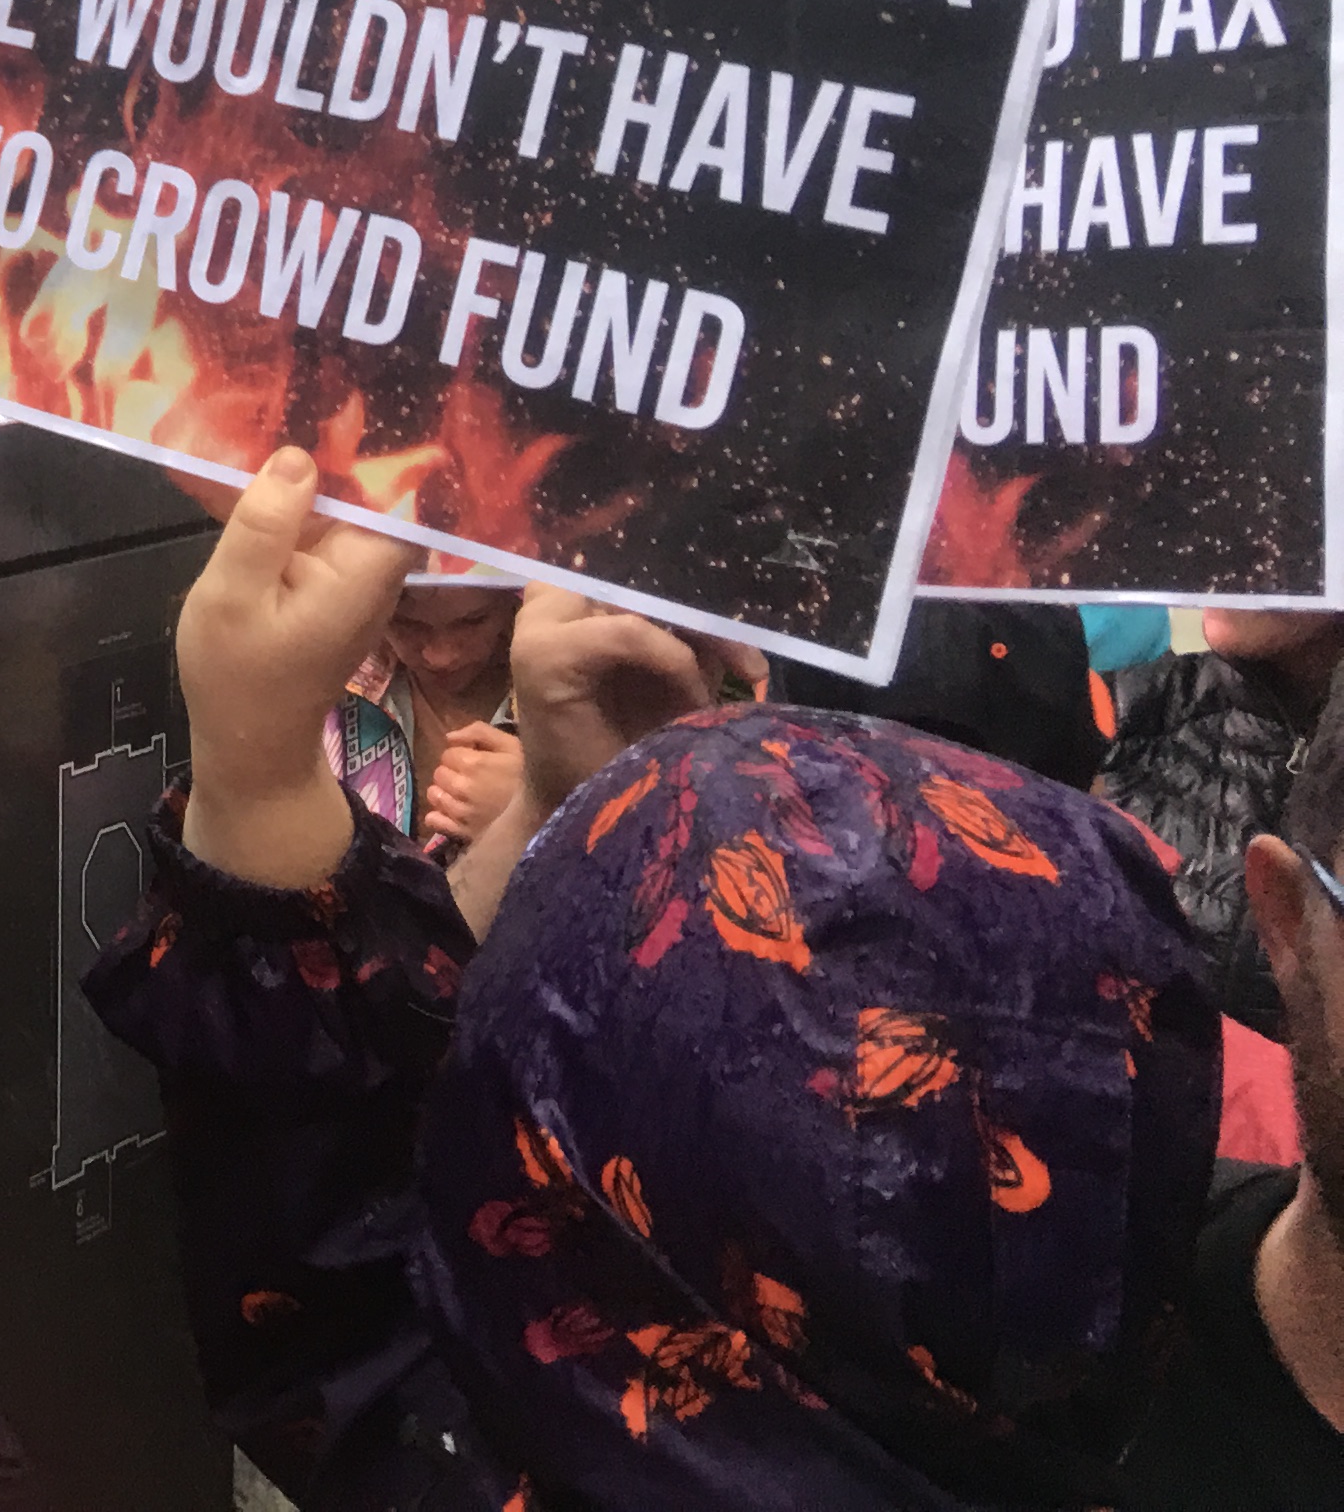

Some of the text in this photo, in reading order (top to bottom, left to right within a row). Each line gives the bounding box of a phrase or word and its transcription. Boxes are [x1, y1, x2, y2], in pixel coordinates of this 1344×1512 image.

[595, 44, 915, 234] HAVE
[1004, 125, 1258, 255] HAVE
[68, 149, 422, 345] CROWD
[439, 238, 744, 429] FUND
[959, 326, 1158, 446] UND
